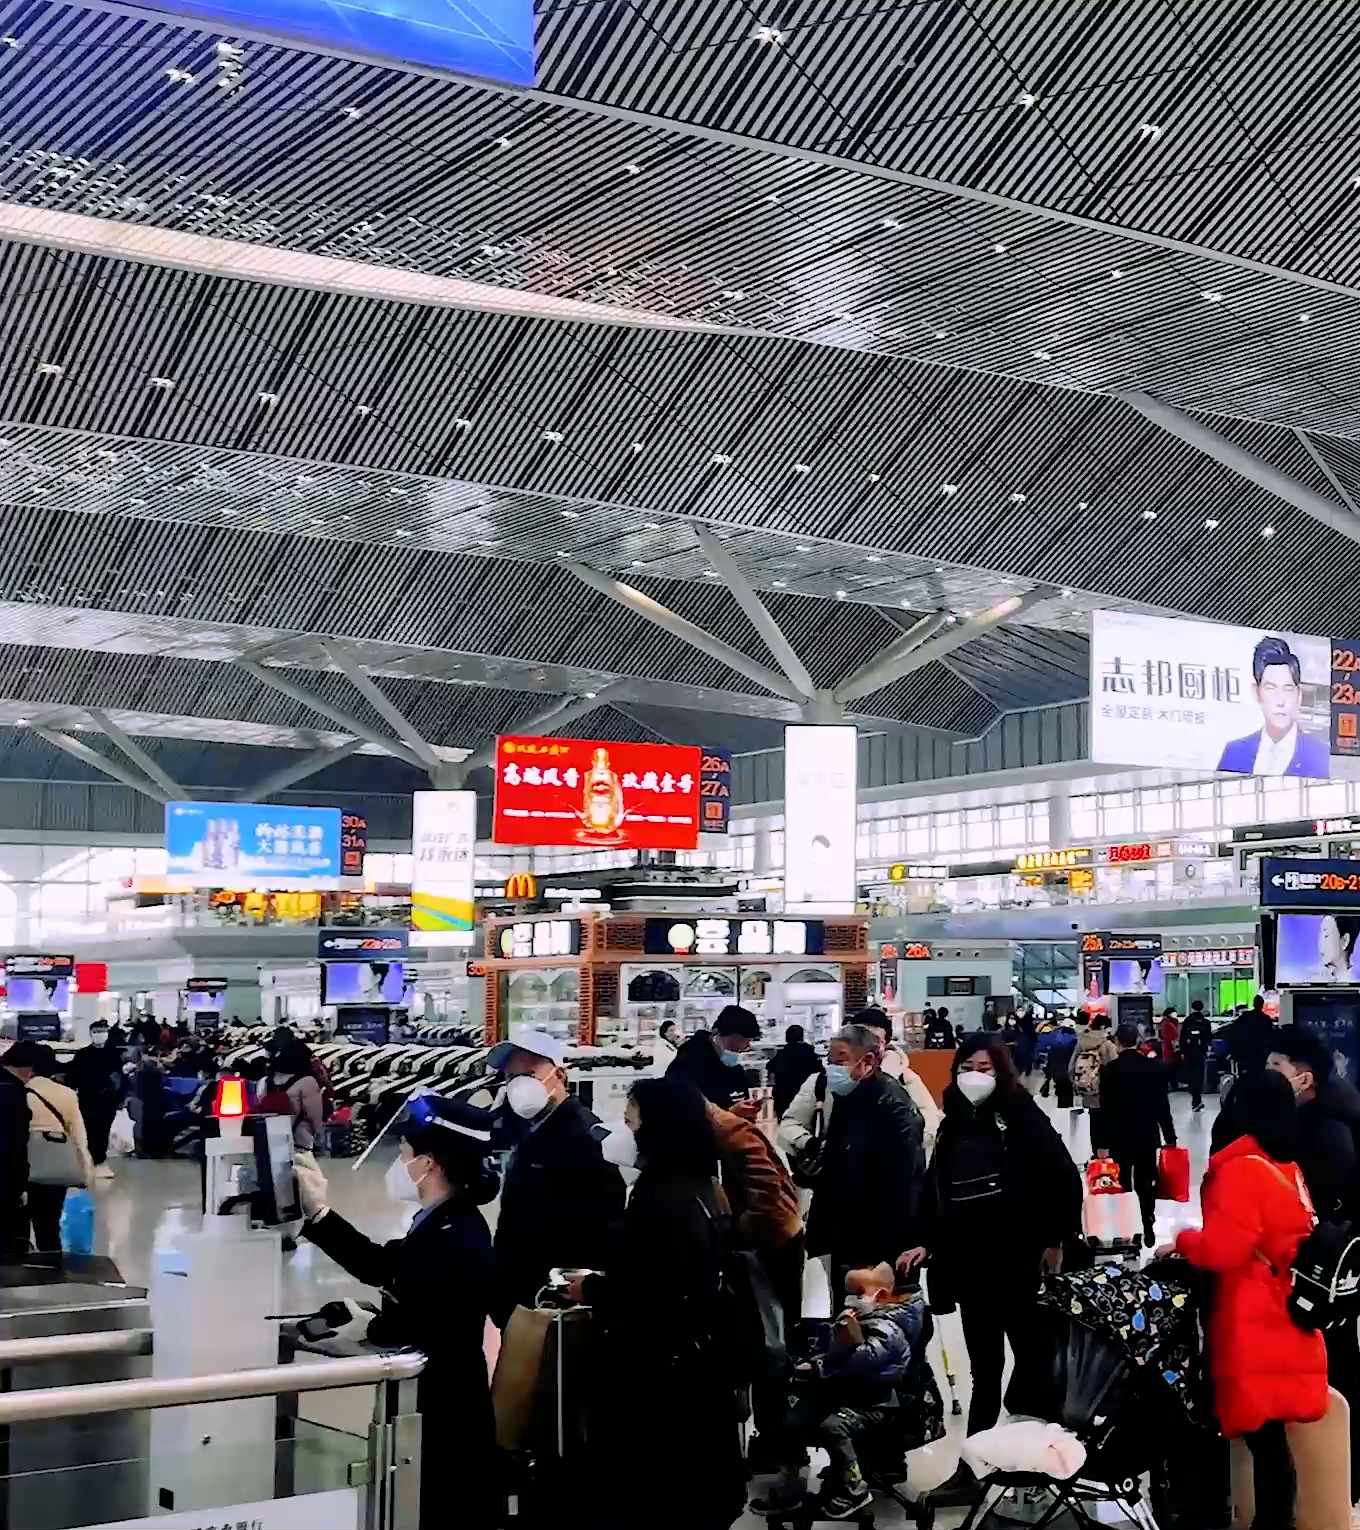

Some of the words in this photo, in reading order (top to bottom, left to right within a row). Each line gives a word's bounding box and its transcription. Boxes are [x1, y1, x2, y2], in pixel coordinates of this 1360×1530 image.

[1100, 656, 1241, 703] 志邦厨柜
[702, 756, 730, 773] 26A
[701, 780, 730, 798] 27A
[342, 815, 367, 829] 30A
[342, 835, 365, 848] 31A
